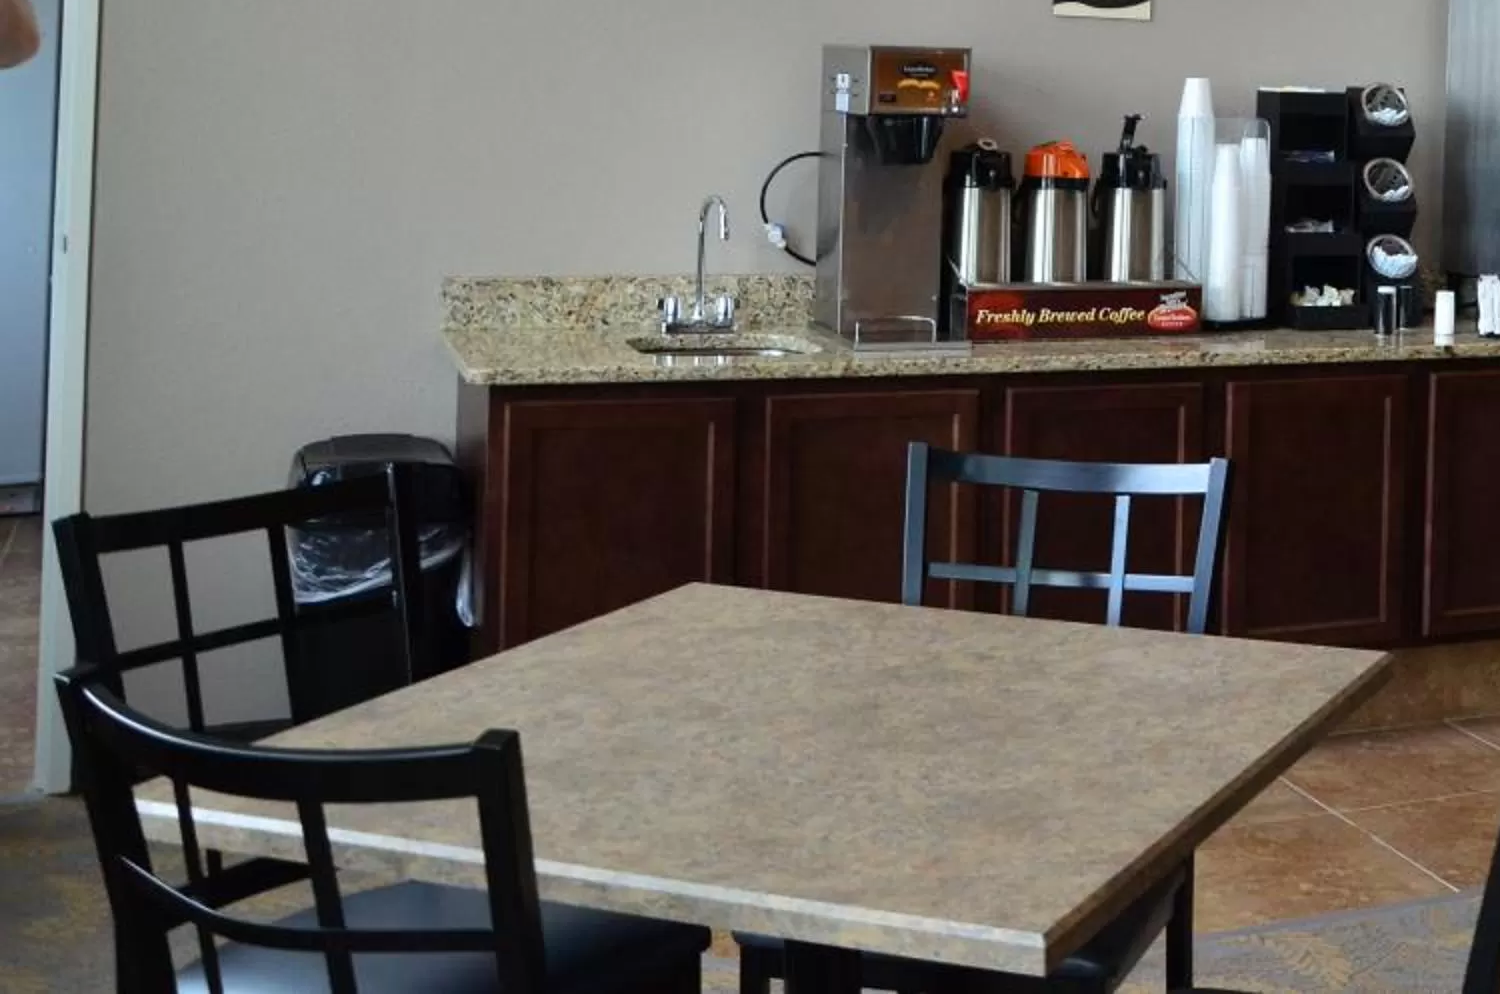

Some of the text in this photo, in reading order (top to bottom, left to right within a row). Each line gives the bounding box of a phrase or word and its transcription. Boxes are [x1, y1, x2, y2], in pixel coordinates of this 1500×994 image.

[975, 306, 1145, 327] Freshly Brewed Coffee
